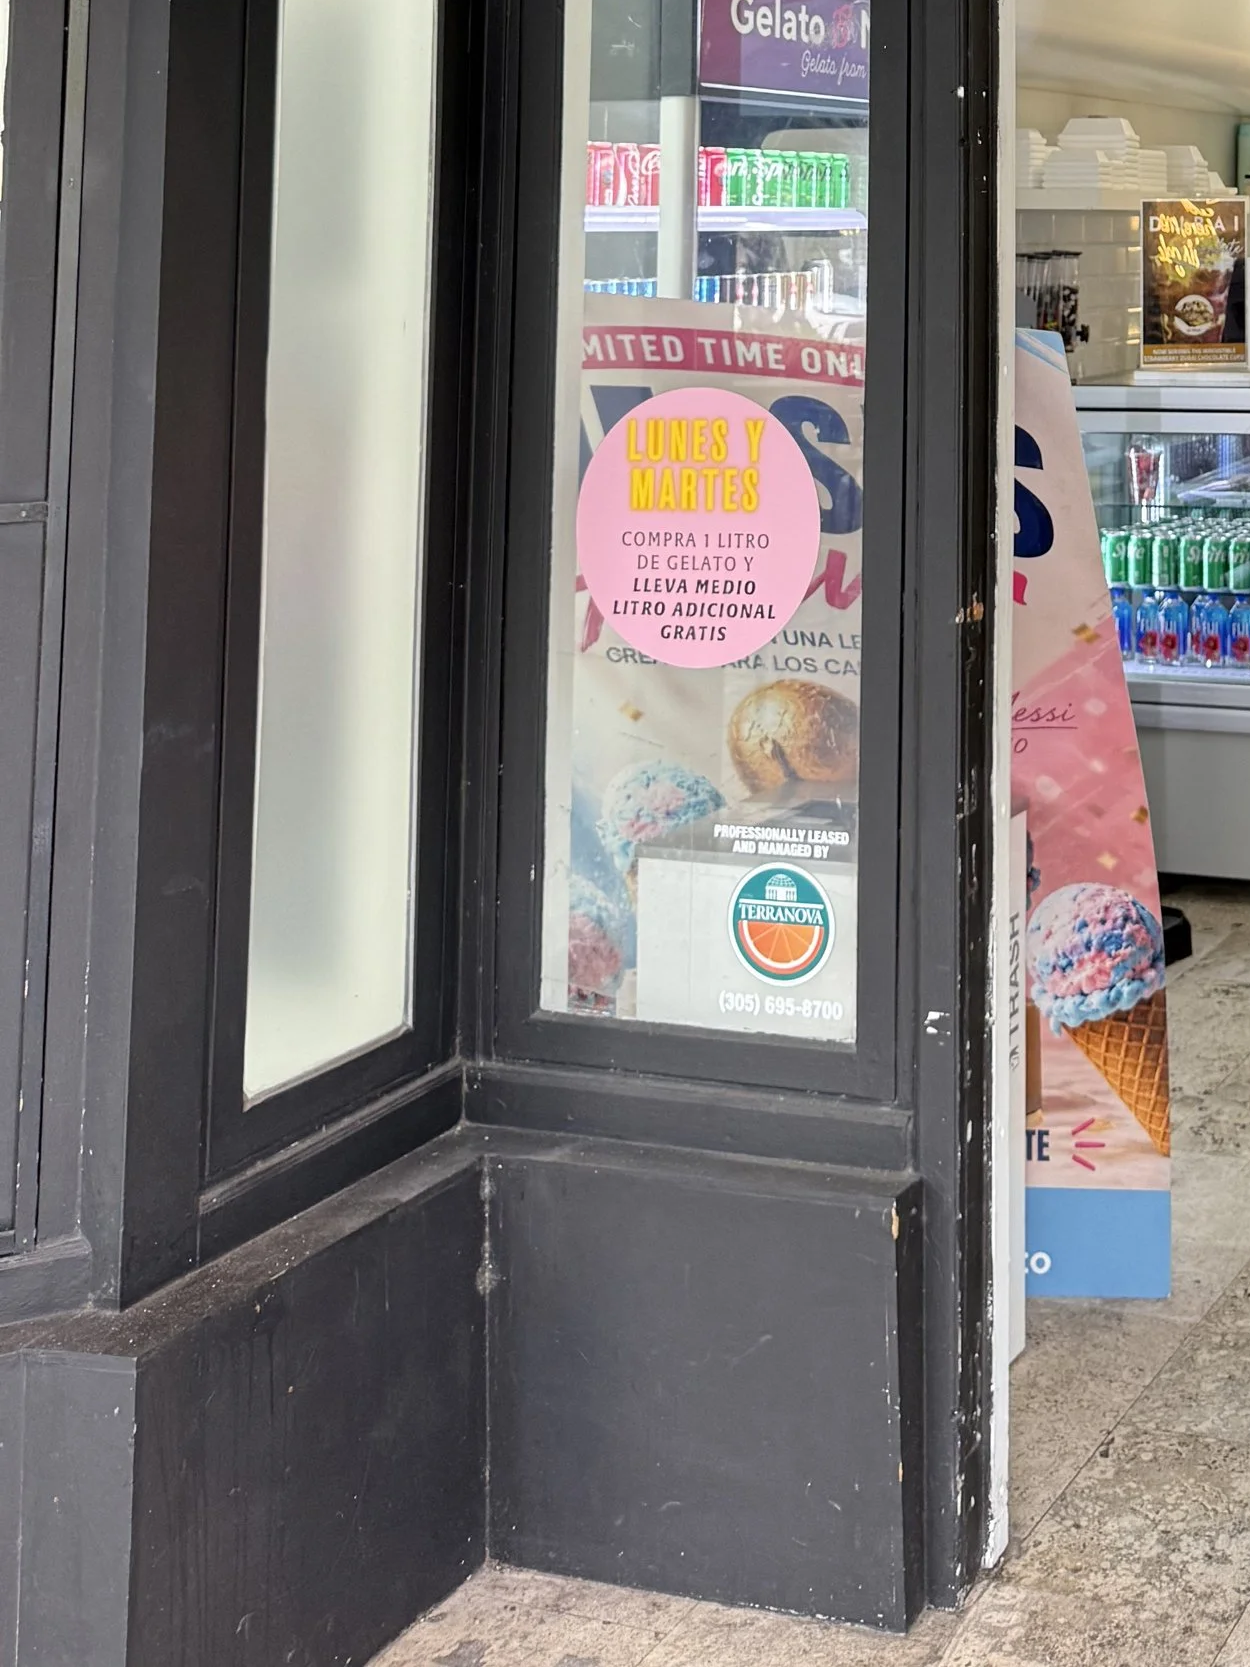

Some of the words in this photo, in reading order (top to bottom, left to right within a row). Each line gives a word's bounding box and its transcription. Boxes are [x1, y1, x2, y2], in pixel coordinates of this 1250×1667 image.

[801, 50, 837, 78] Gelato
[836, 52, 867, 86] from
[697, 337, 786, 371] TIME
[626, 417, 729, 463] LUNES
[744, 419, 767, 463] Y
[629, 467, 760, 513] MARTES
[621, 530, 697, 548] COMPRA
[703, 532, 710, 549] 1
[717, 532, 770, 550] LITRO
[636, 554, 660, 571] DE
[666, 555, 737, 573] GELATO
[743, 555, 755, 573] Y
[632, 578, 689, 594] LLEVA
[694, 579, 757, 596] MEDIO
[612, 600, 666, 617] LITRO
[671, 602, 777, 620] ADICIONAL
[659, 624, 728, 642] GRATIS
[782, 629, 834, 648] UNA
[773, 655, 819, 674] LOS
[713, 823, 806, 843] PROFESSIONALLY
[807, 829, 850, 846] LEASED
[732, 840, 757, 854] AND
[757, 840, 812, 858] MANAGED
[813, 845, 830, 859] BY
[738, 904, 824, 925] TERRANOVA
[718, 989, 761, 1016] (305)
[764, 994, 844, 1021] 695-8700
